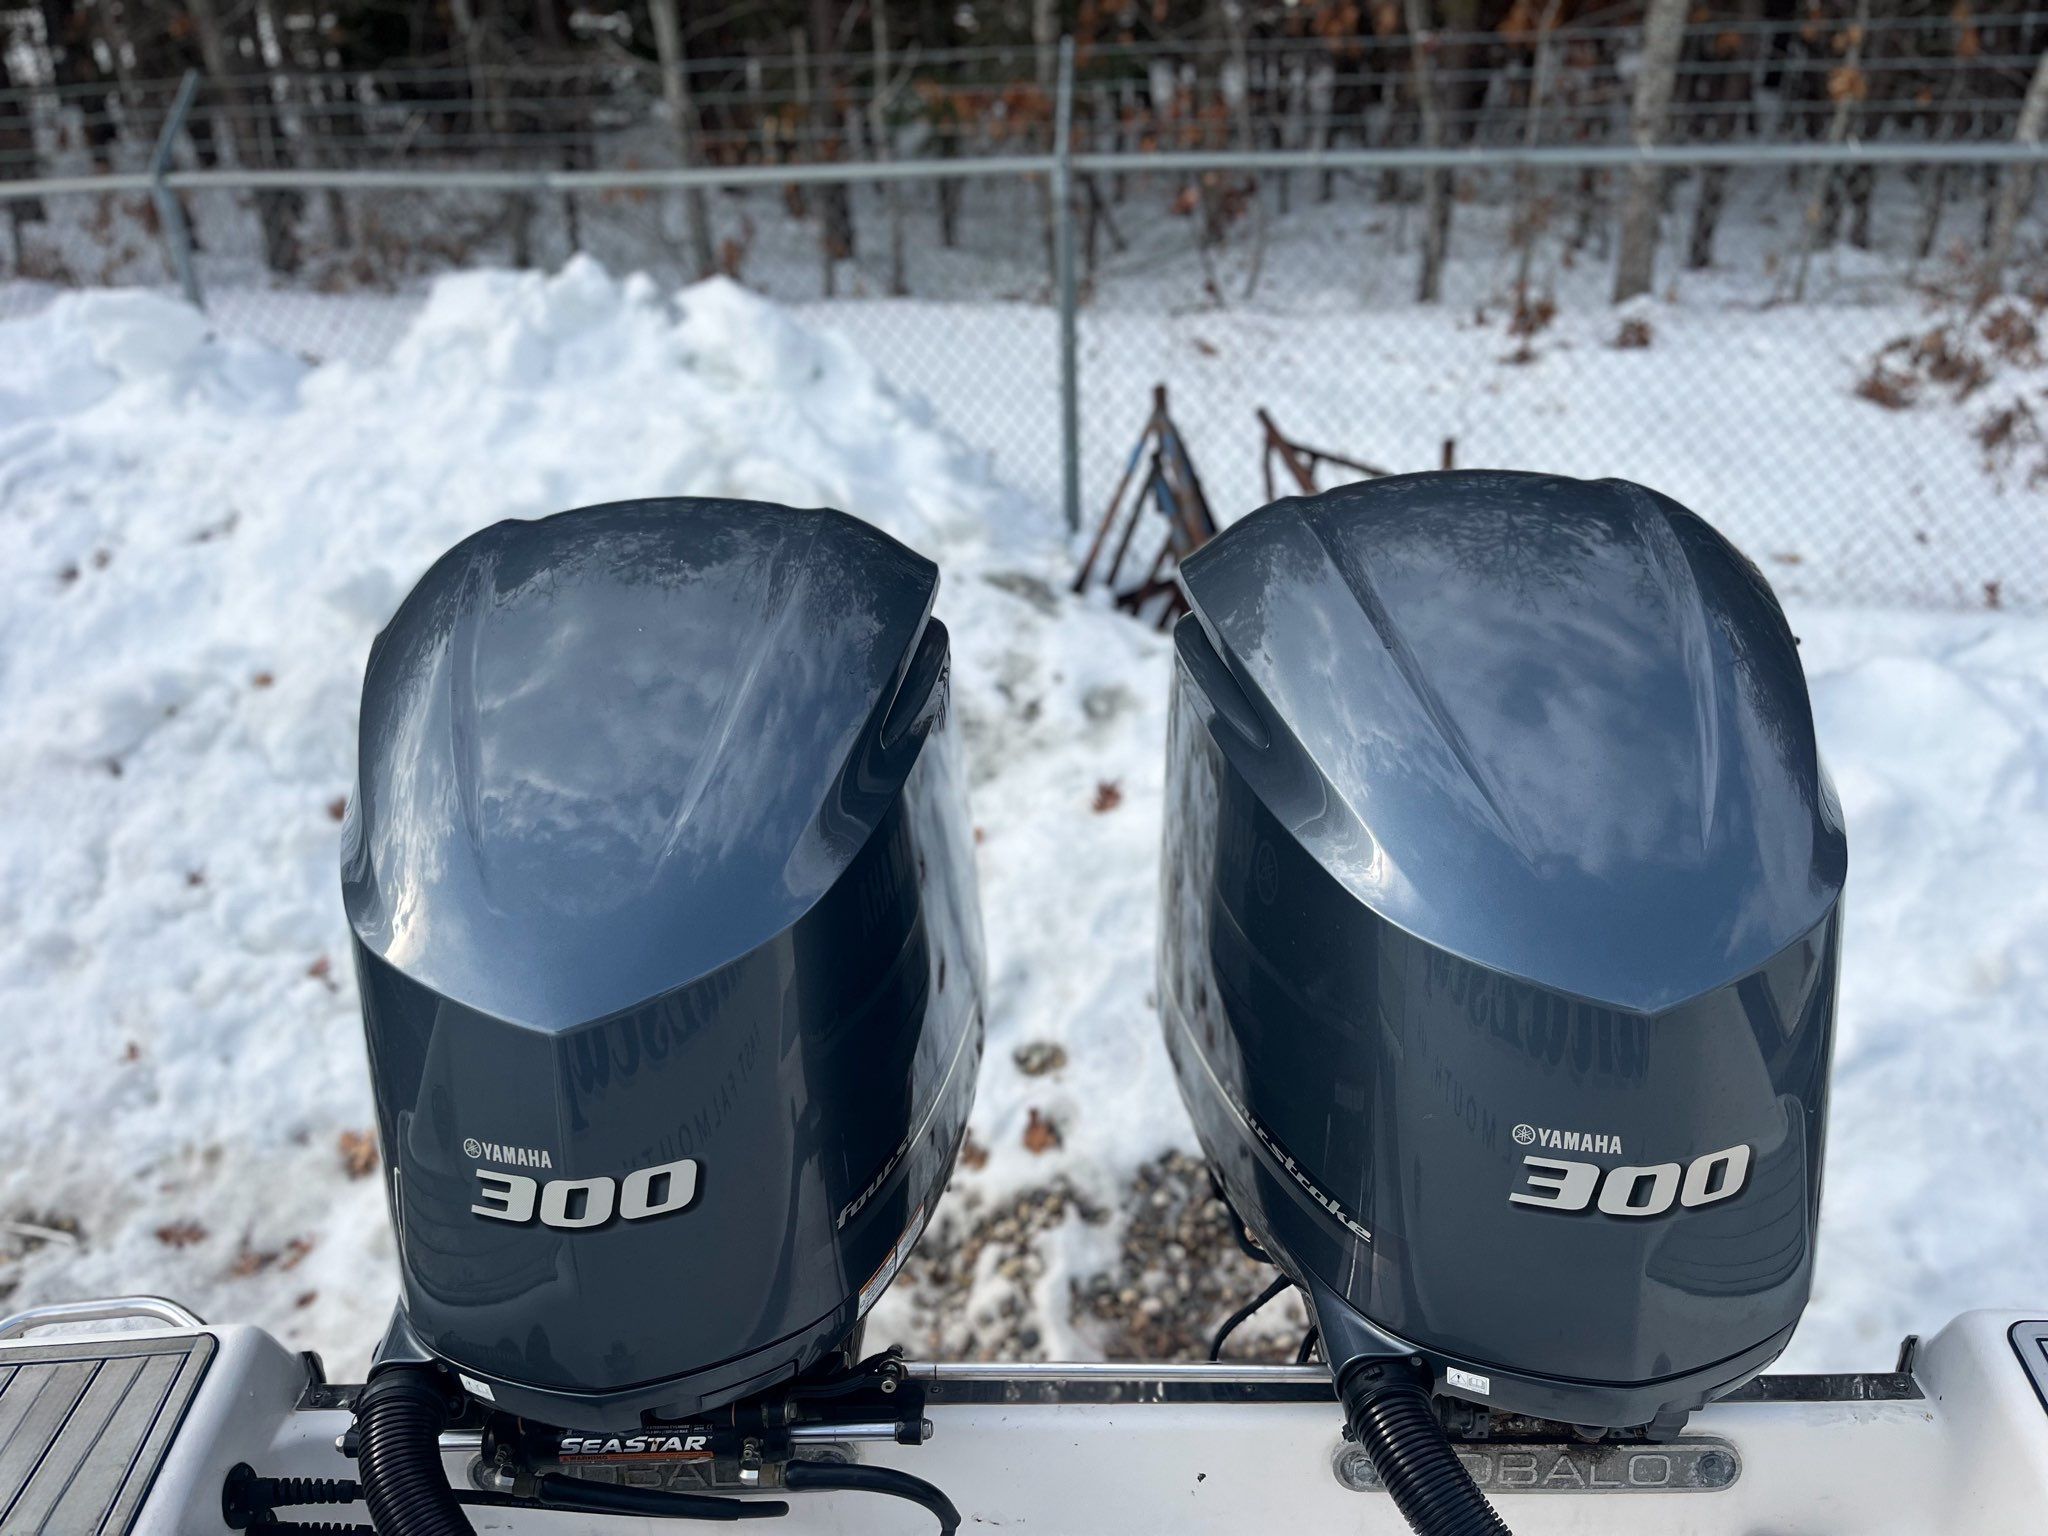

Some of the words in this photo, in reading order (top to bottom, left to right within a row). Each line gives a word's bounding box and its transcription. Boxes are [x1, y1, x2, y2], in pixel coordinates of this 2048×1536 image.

[481, 1142, 553, 1169] YAMAHA
[1537, 1127, 1623, 1155] YAMAHA
[471, 1158, 698, 1228] 300
[1508, 1143, 1751, 1216] 300
[558, 1435, 708, 1455] SEASTAR
[1455, 1453, 1672, 1487] OBALO
